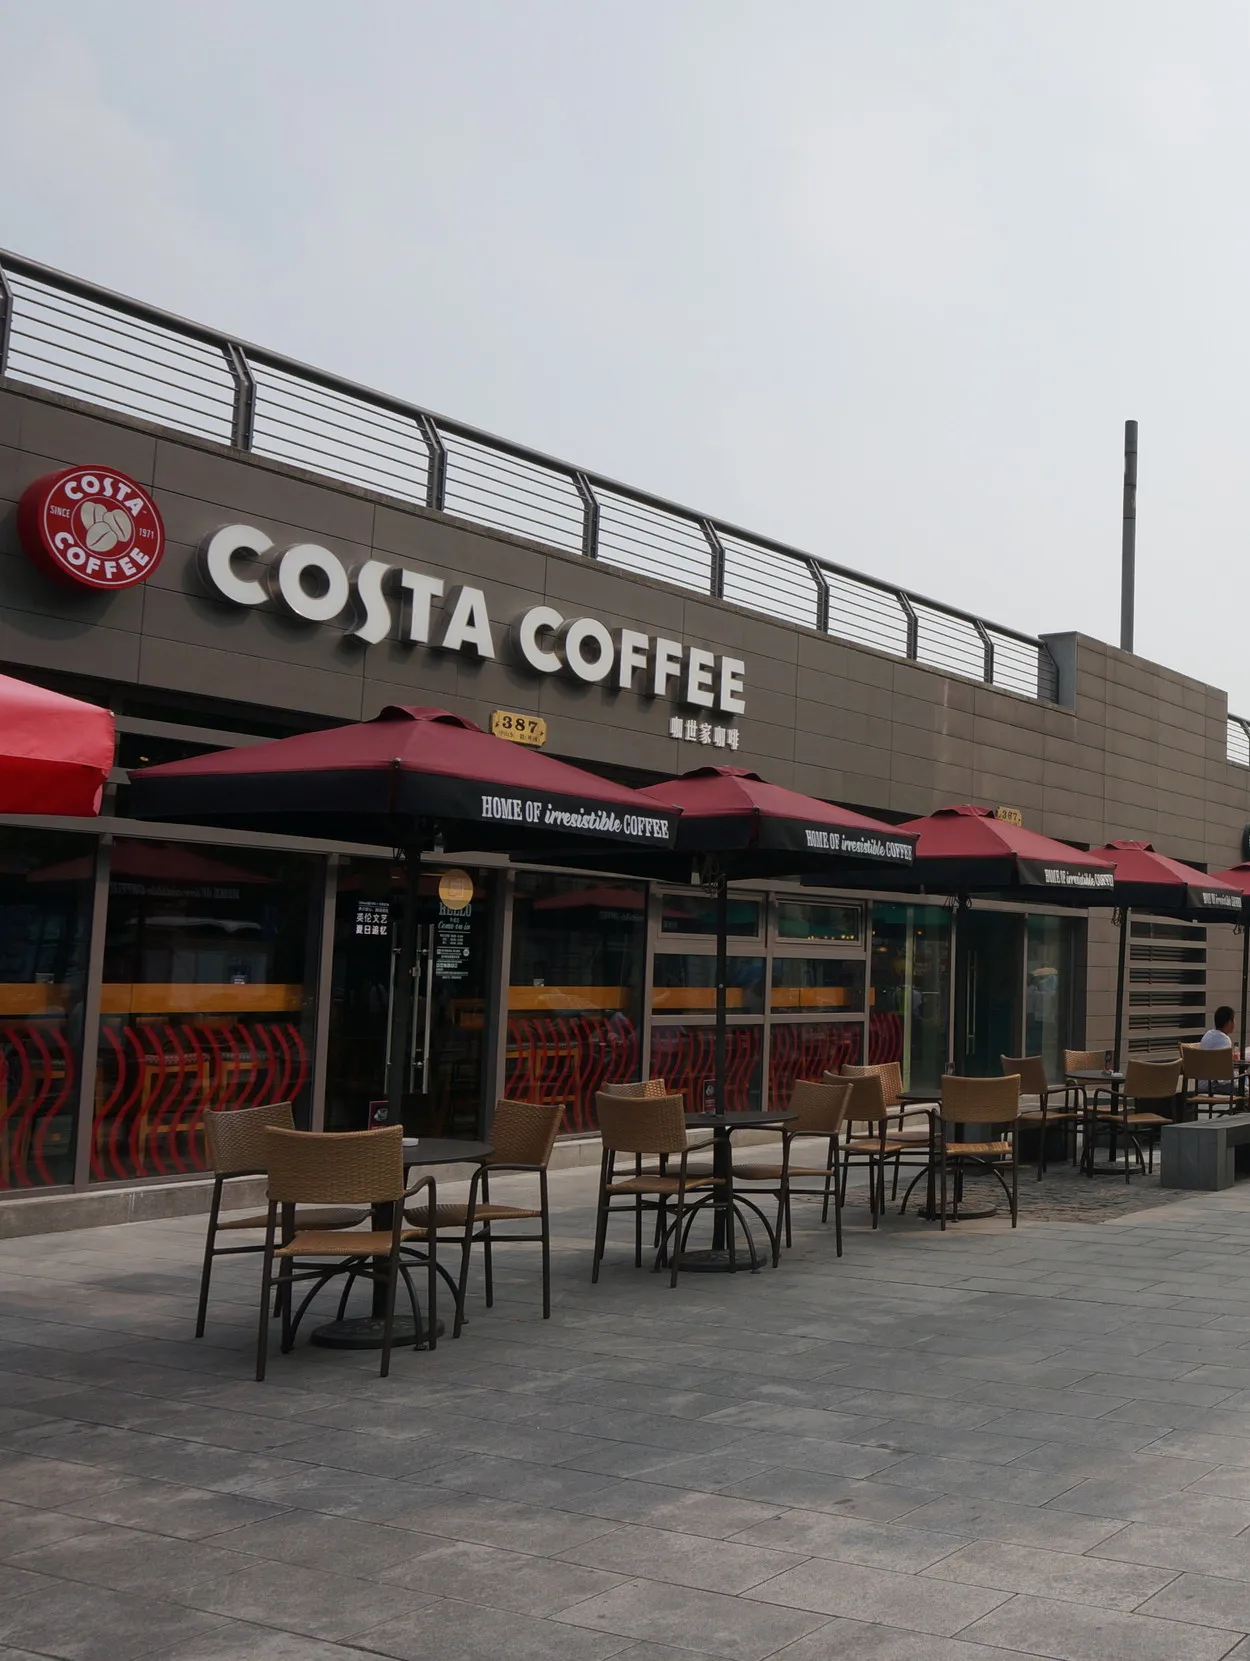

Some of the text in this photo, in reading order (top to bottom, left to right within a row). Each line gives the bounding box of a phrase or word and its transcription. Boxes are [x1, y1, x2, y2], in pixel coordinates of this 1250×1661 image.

[50, 505, 71, 518] SINCE
[65, 475, 144, 517] COSTA
[139, 528, 154, 539] 1971
[54, 532, 150, 579] COFFEE
[207, 524, 746, 714] COSTA COFFEE
[502, 716, 538, 733] 387
[669, 716, 740, 750] 咖世家咖啡
[481, 796, 669, 839] HOME OF irresistible COFFEE
[805, 829, 913, 861] HOME OF irresistible COFFEE
[356, 913, 388, 923] 英伦文艺
